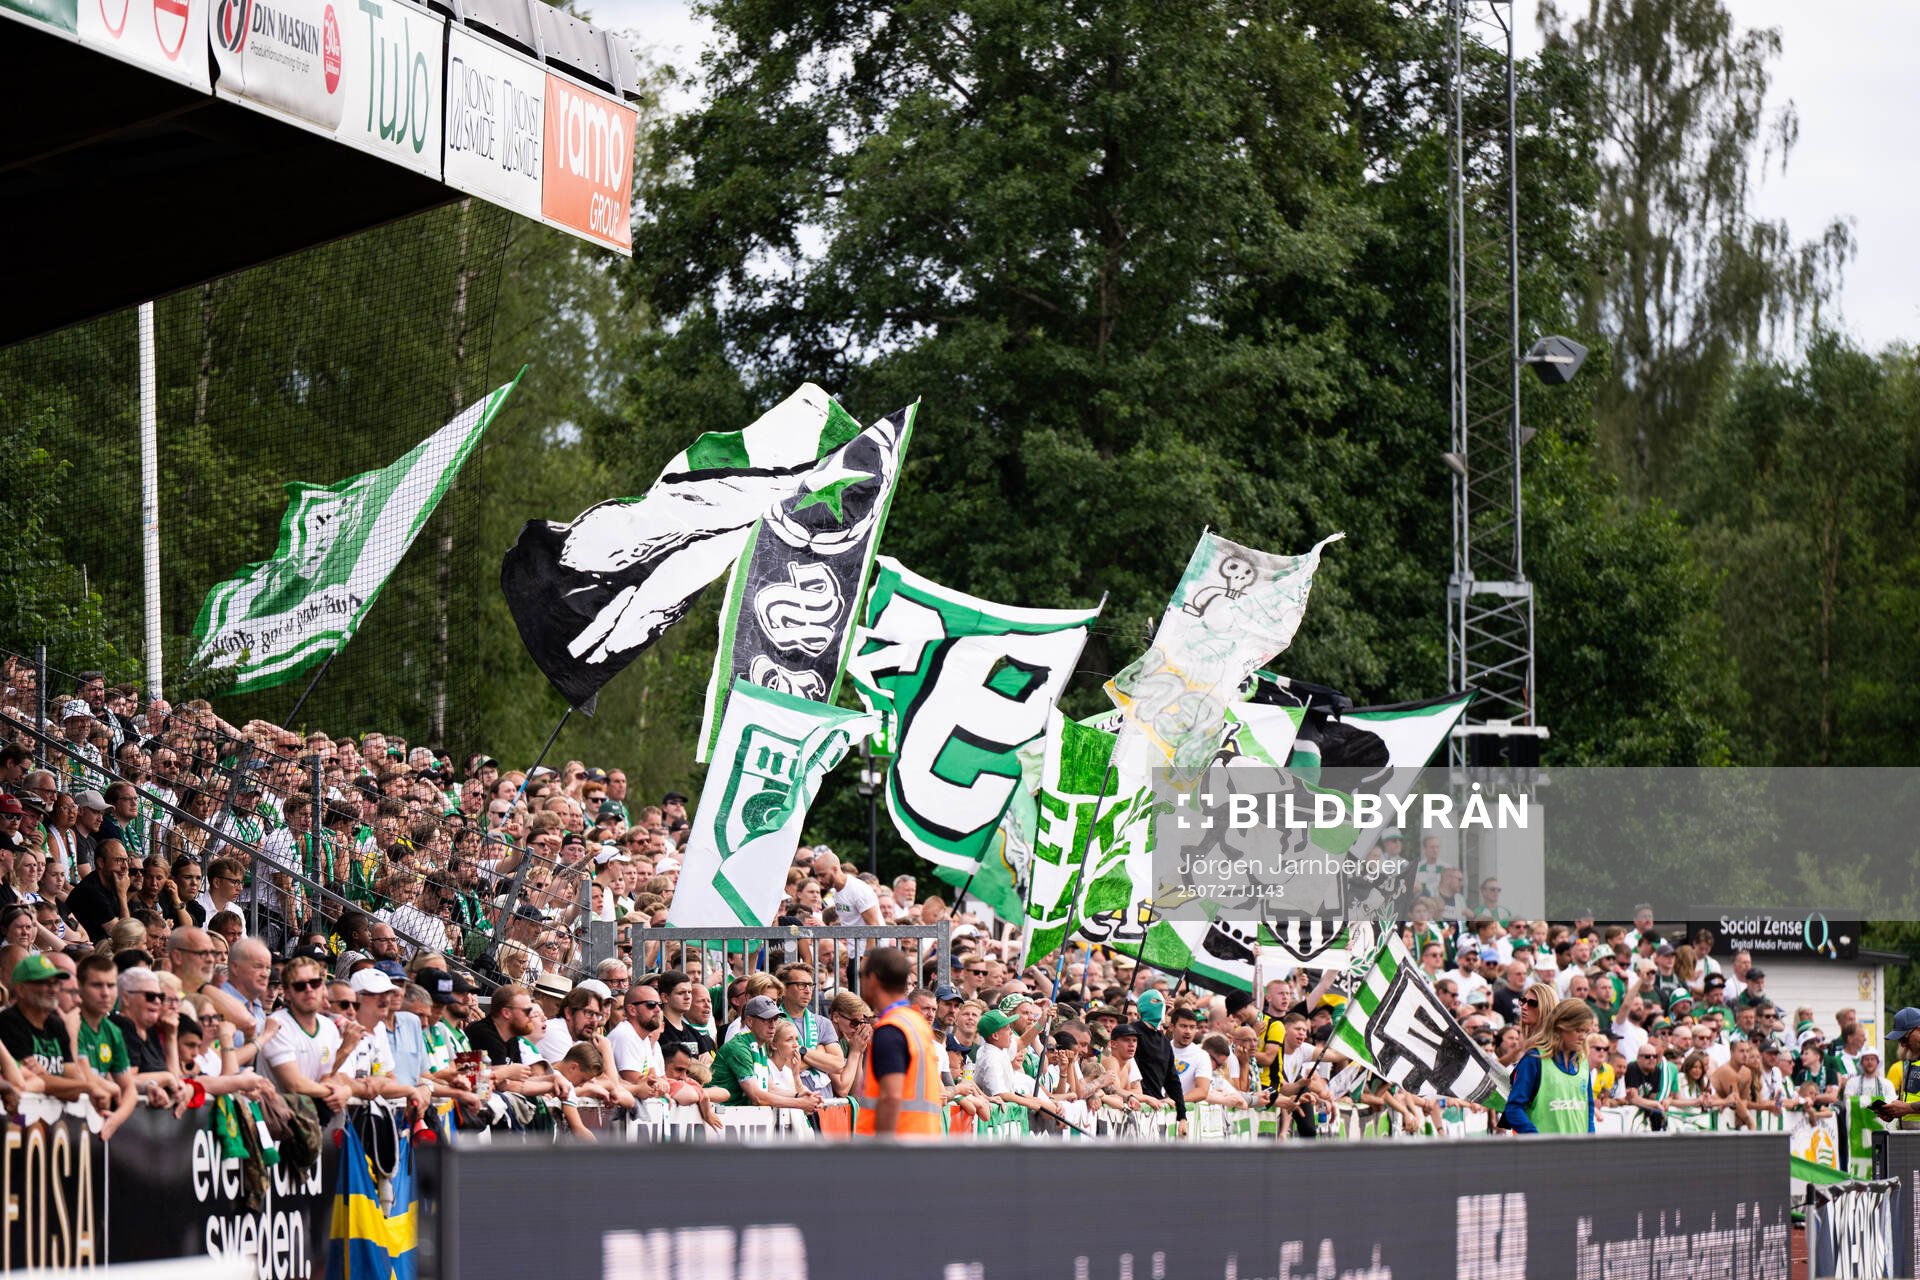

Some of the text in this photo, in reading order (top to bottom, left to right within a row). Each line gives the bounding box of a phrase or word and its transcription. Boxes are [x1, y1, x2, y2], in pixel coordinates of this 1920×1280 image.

[252, 3, 320, 56] DIN MASKIN
[465, 65, 495, 116] KONST
[513, 88, 540, 137] KONST
[463, 109, 495, 161] SMIDE
[513, 131, 539, 180] SMIDE
[558, 90, 625, 192] ramo
[590, 192, 621, 238] GROUP
[1720, 915, 1803, 936] Social Zense
[1730, 938, 1803, 950] Digital Media Partner
